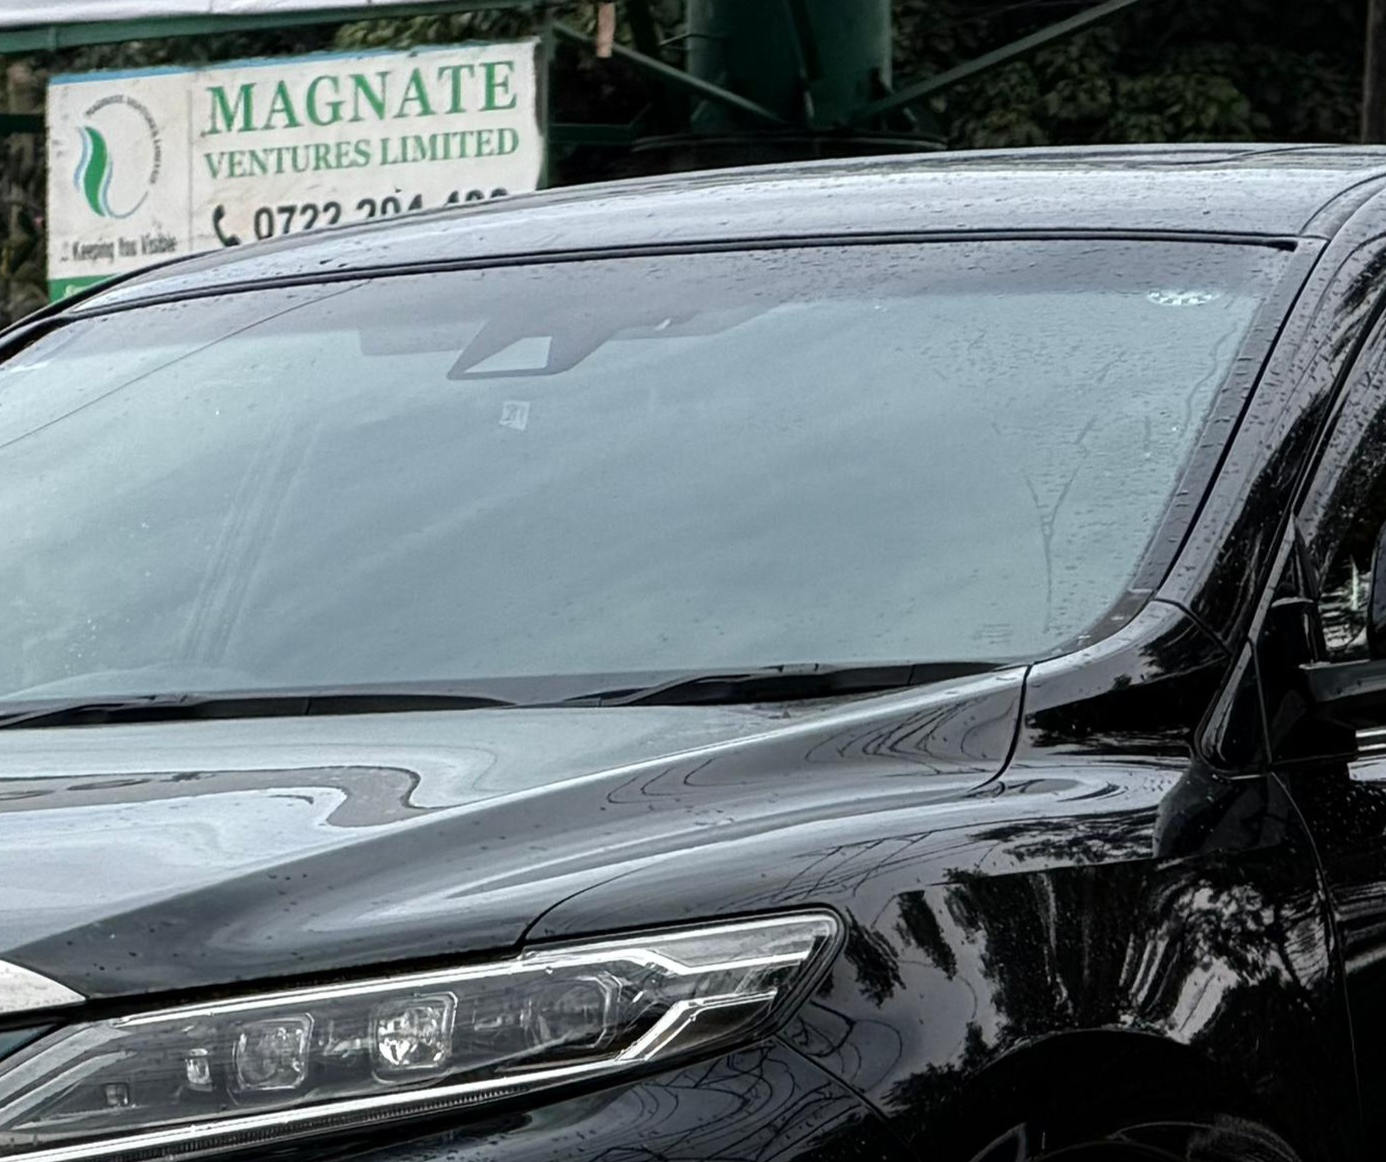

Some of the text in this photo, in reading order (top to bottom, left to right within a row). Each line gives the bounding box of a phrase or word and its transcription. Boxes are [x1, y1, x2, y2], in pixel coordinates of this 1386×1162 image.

[204, 60, 518, 135] MAGNATE
[204, 139, 371, 179] VENTURES
[380, 128, 519, 165] LIMITED
